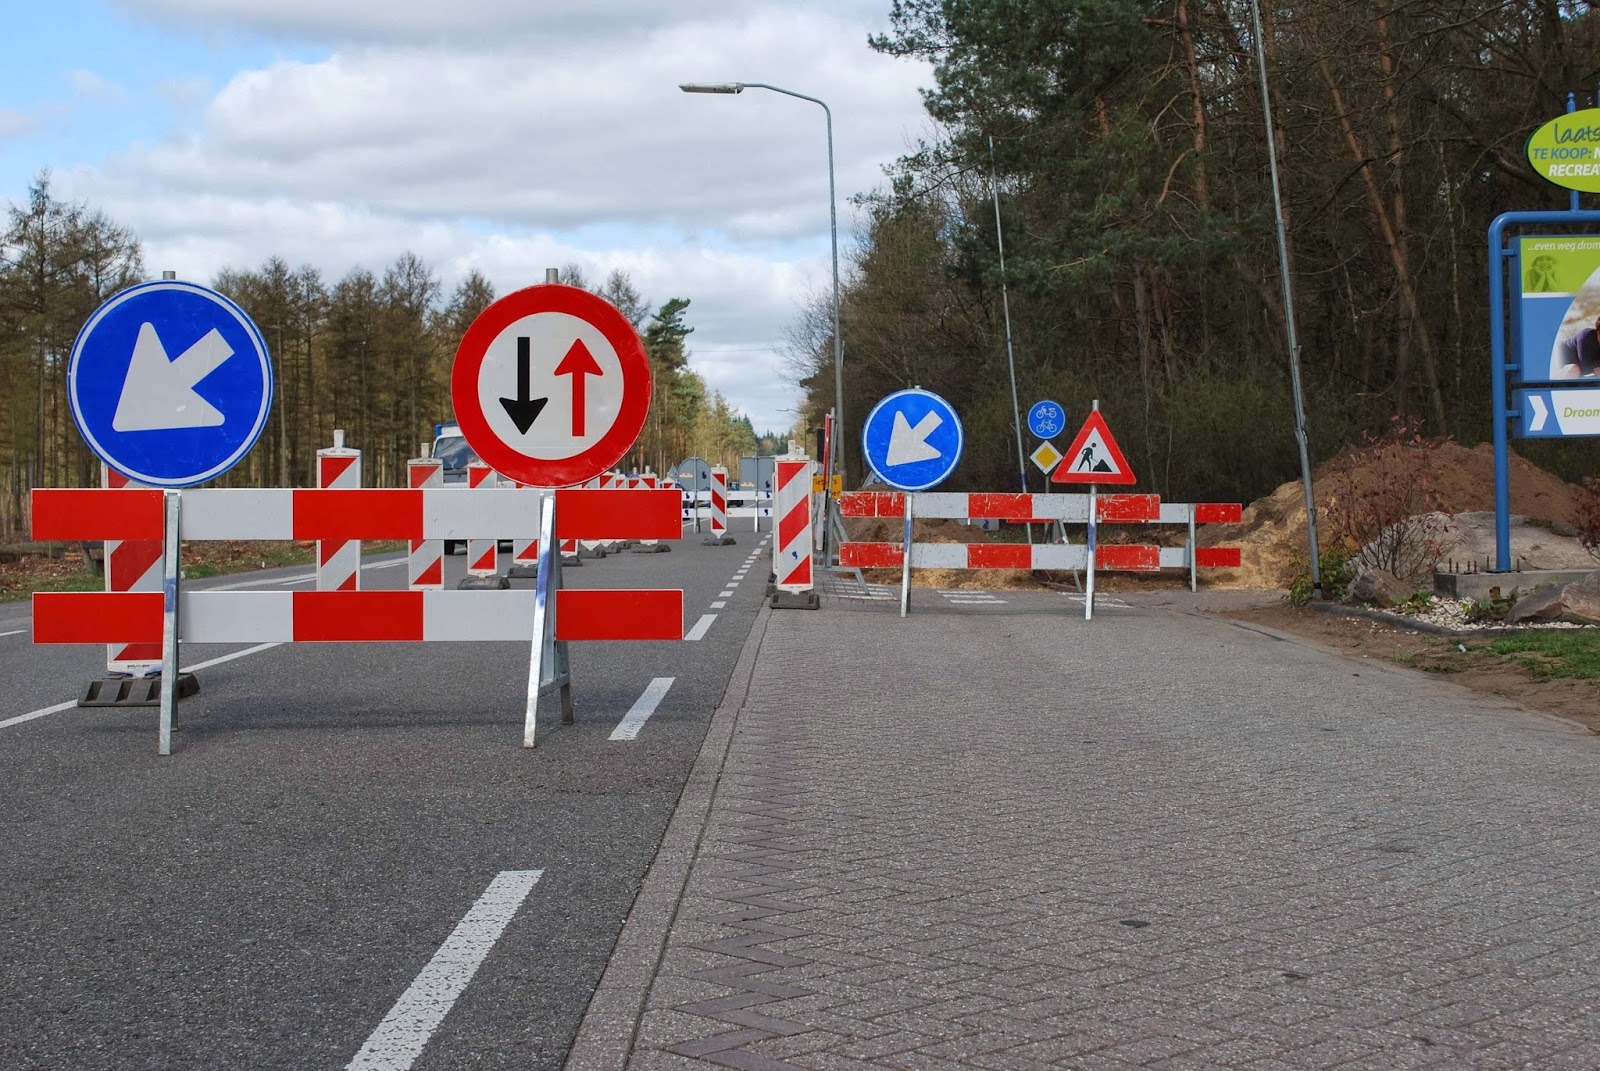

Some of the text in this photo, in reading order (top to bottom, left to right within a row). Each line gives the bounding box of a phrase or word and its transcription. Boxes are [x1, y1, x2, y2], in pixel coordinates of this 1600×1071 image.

[1533, 148, 1548, 160] TE
[1551, 147, 1591, 160] KOOP:
[1549, 164, 1600, 177] RECREA
[1558, 242, 1575, 252] weg
